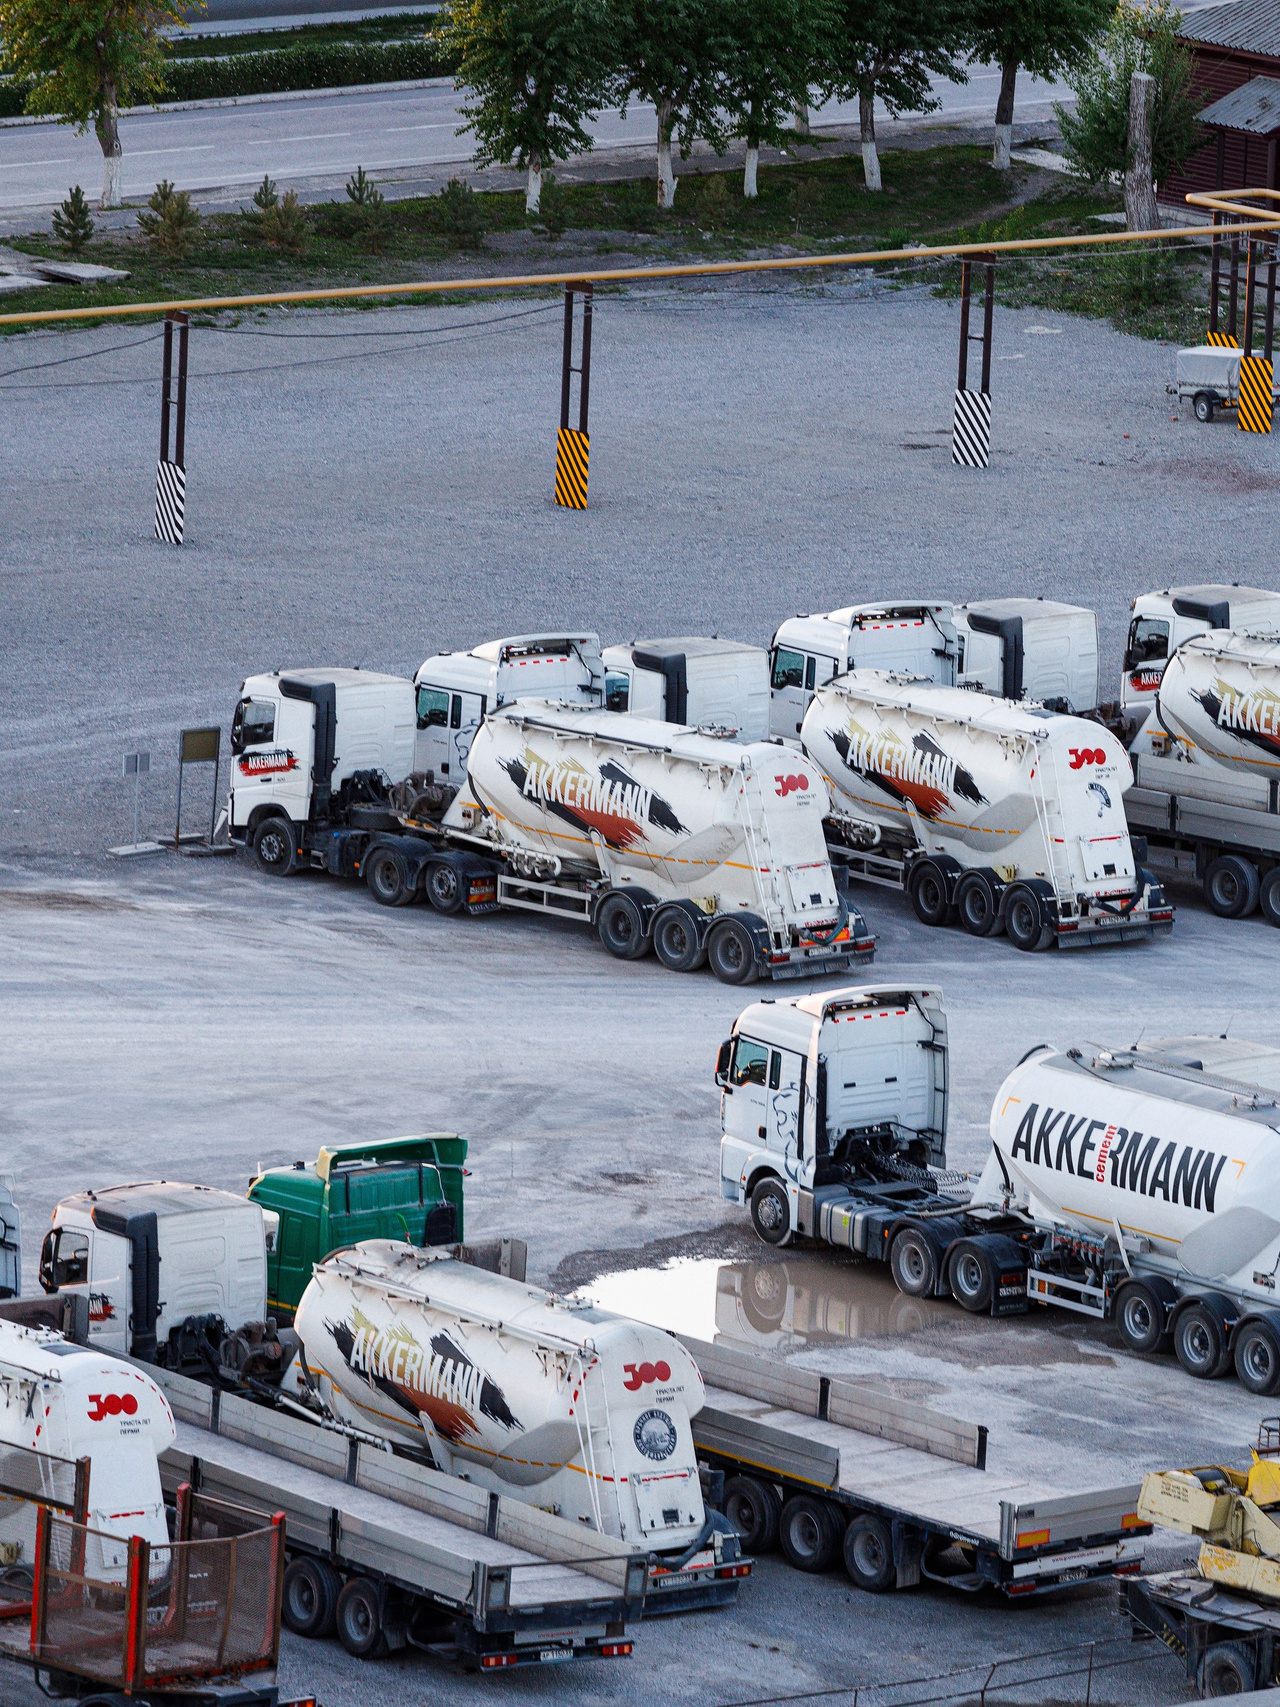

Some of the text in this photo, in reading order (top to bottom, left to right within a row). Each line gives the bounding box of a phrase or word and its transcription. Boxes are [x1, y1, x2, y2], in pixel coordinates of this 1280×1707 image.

[1141, 671, 1163, 686] AKKER
[248, 753, 289, 770] AKKERMANN
[846, 732, 958, 793] AKKERMANN
[523, 762, 653, 822] AKKERMANN
[1011, 1102, 1227, 1214] AKKERMANN
[1096, 1124, 1118, 1183] cement
[350, 1327, 486, 1411] AKKERMANN
[623, 1360, 671, 1391] 300
[87, 1393, 138, 1422] 300
[120, 1419, 142, 1427] ТРИСТА
[120, 1428, 140, 1436] ПЕРМИ
